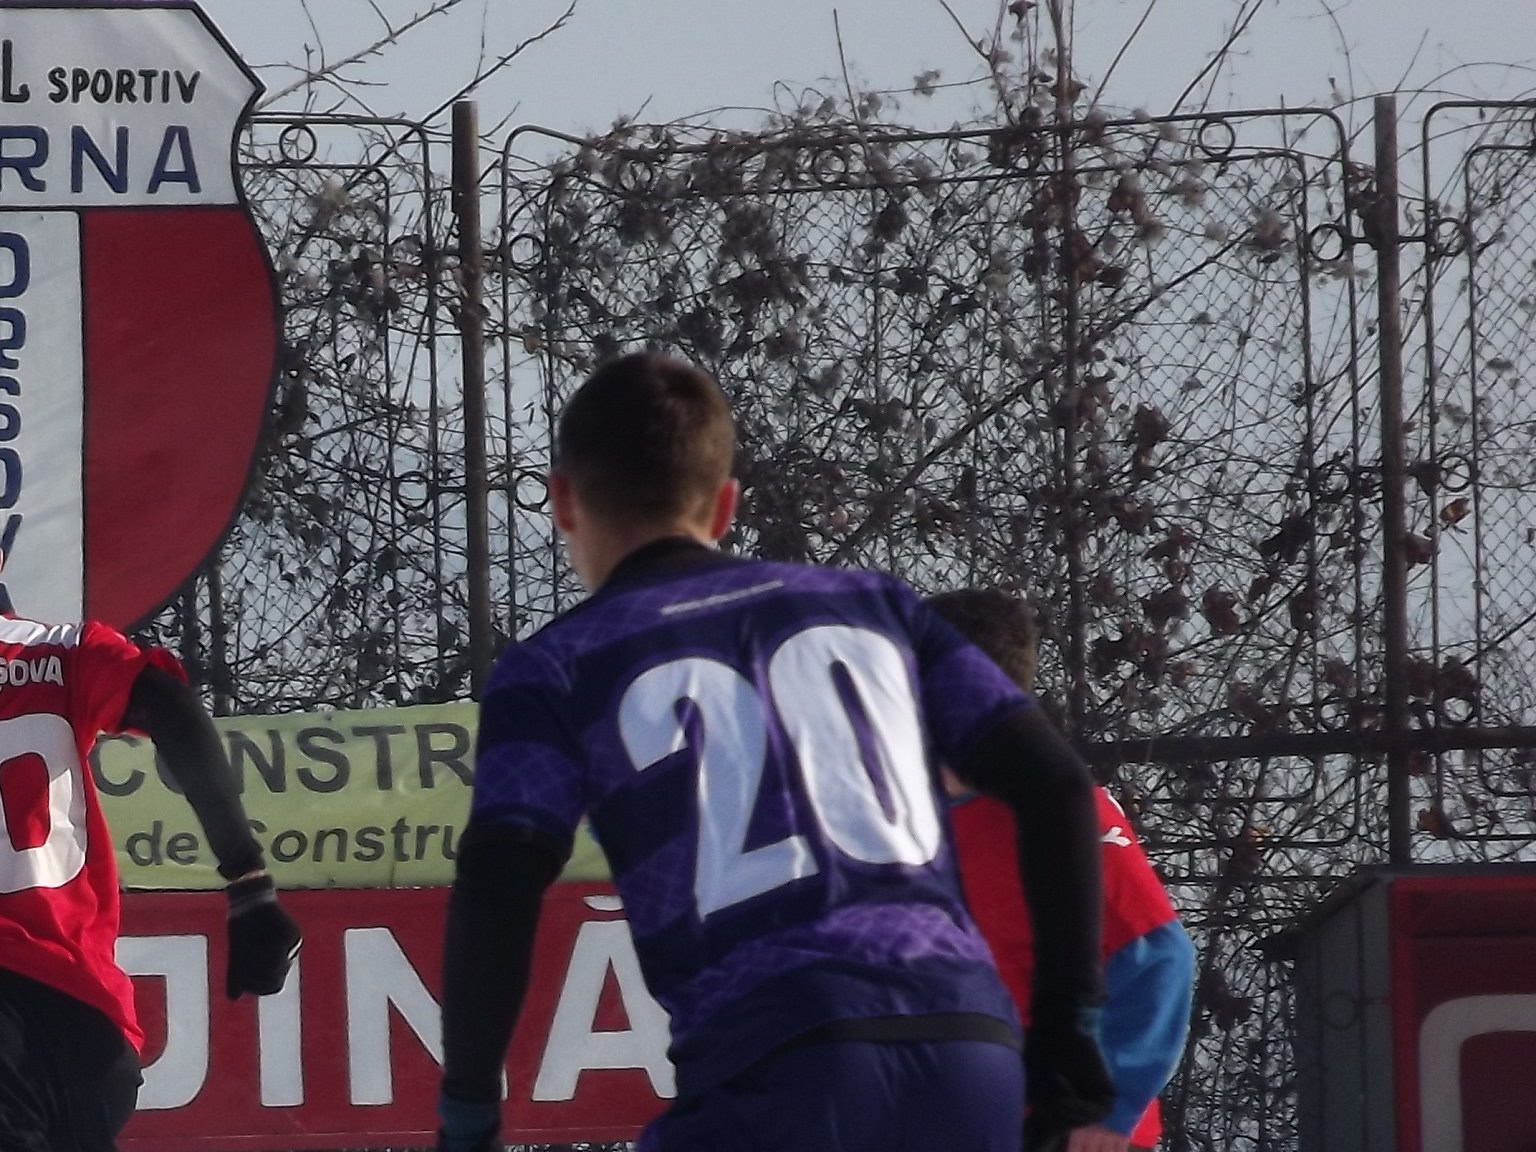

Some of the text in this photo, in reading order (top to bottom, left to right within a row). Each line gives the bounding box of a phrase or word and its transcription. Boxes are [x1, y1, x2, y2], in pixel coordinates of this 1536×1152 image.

[48, 68, 200, 103] SPORTIV
[618, 625, 941, 922] 20
[126, 821, 200, 866] de
